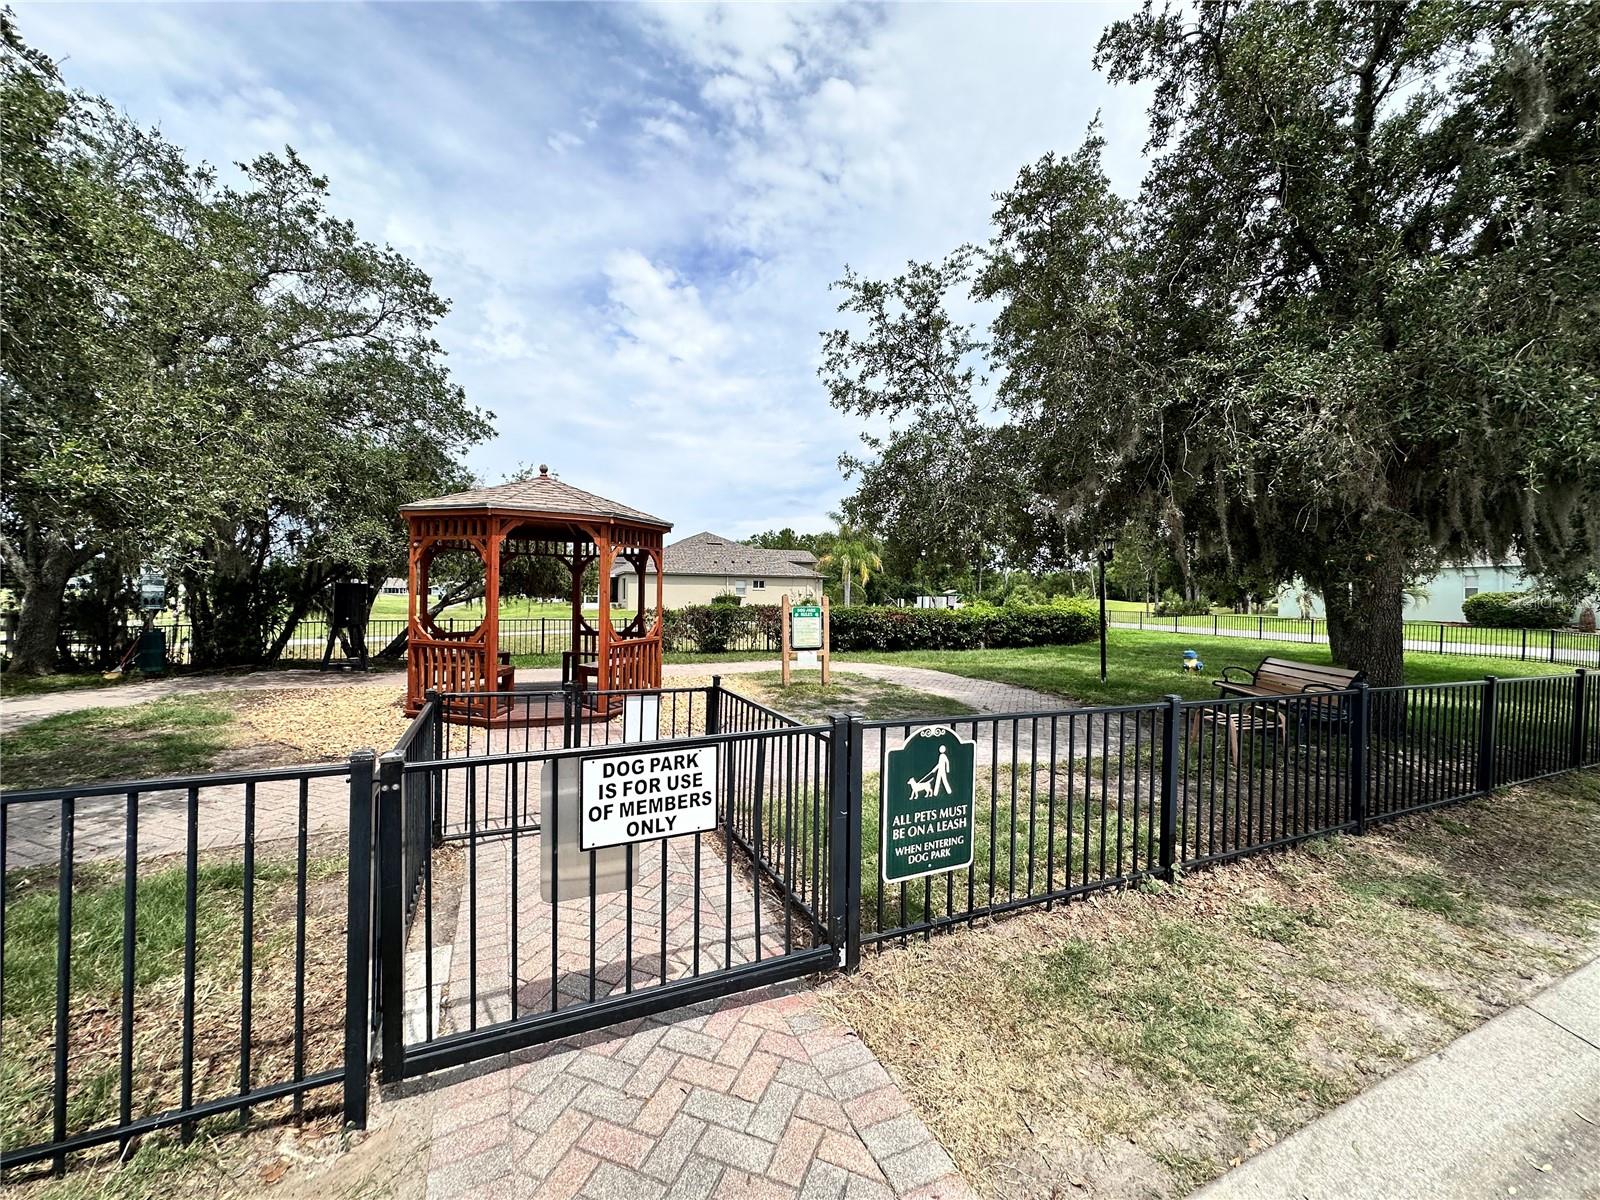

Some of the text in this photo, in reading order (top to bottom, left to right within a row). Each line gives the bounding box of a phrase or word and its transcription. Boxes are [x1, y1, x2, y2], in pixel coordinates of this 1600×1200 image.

[602, 753, 700, 779] DOG PARK
[599, 772, 703, 800] IS FOR USE
[588, 791, 712, 822] OF MEMBERS
[892, 804, 968, 826] ALL PETS MUST
[626, 815, 677, 837] ONLY
[892, 818, 966, 840] BE ON A LEASH
[895, 835, 964, 856] WHEN ENTERING
[908, 848, 951, 864] DOG PARK
